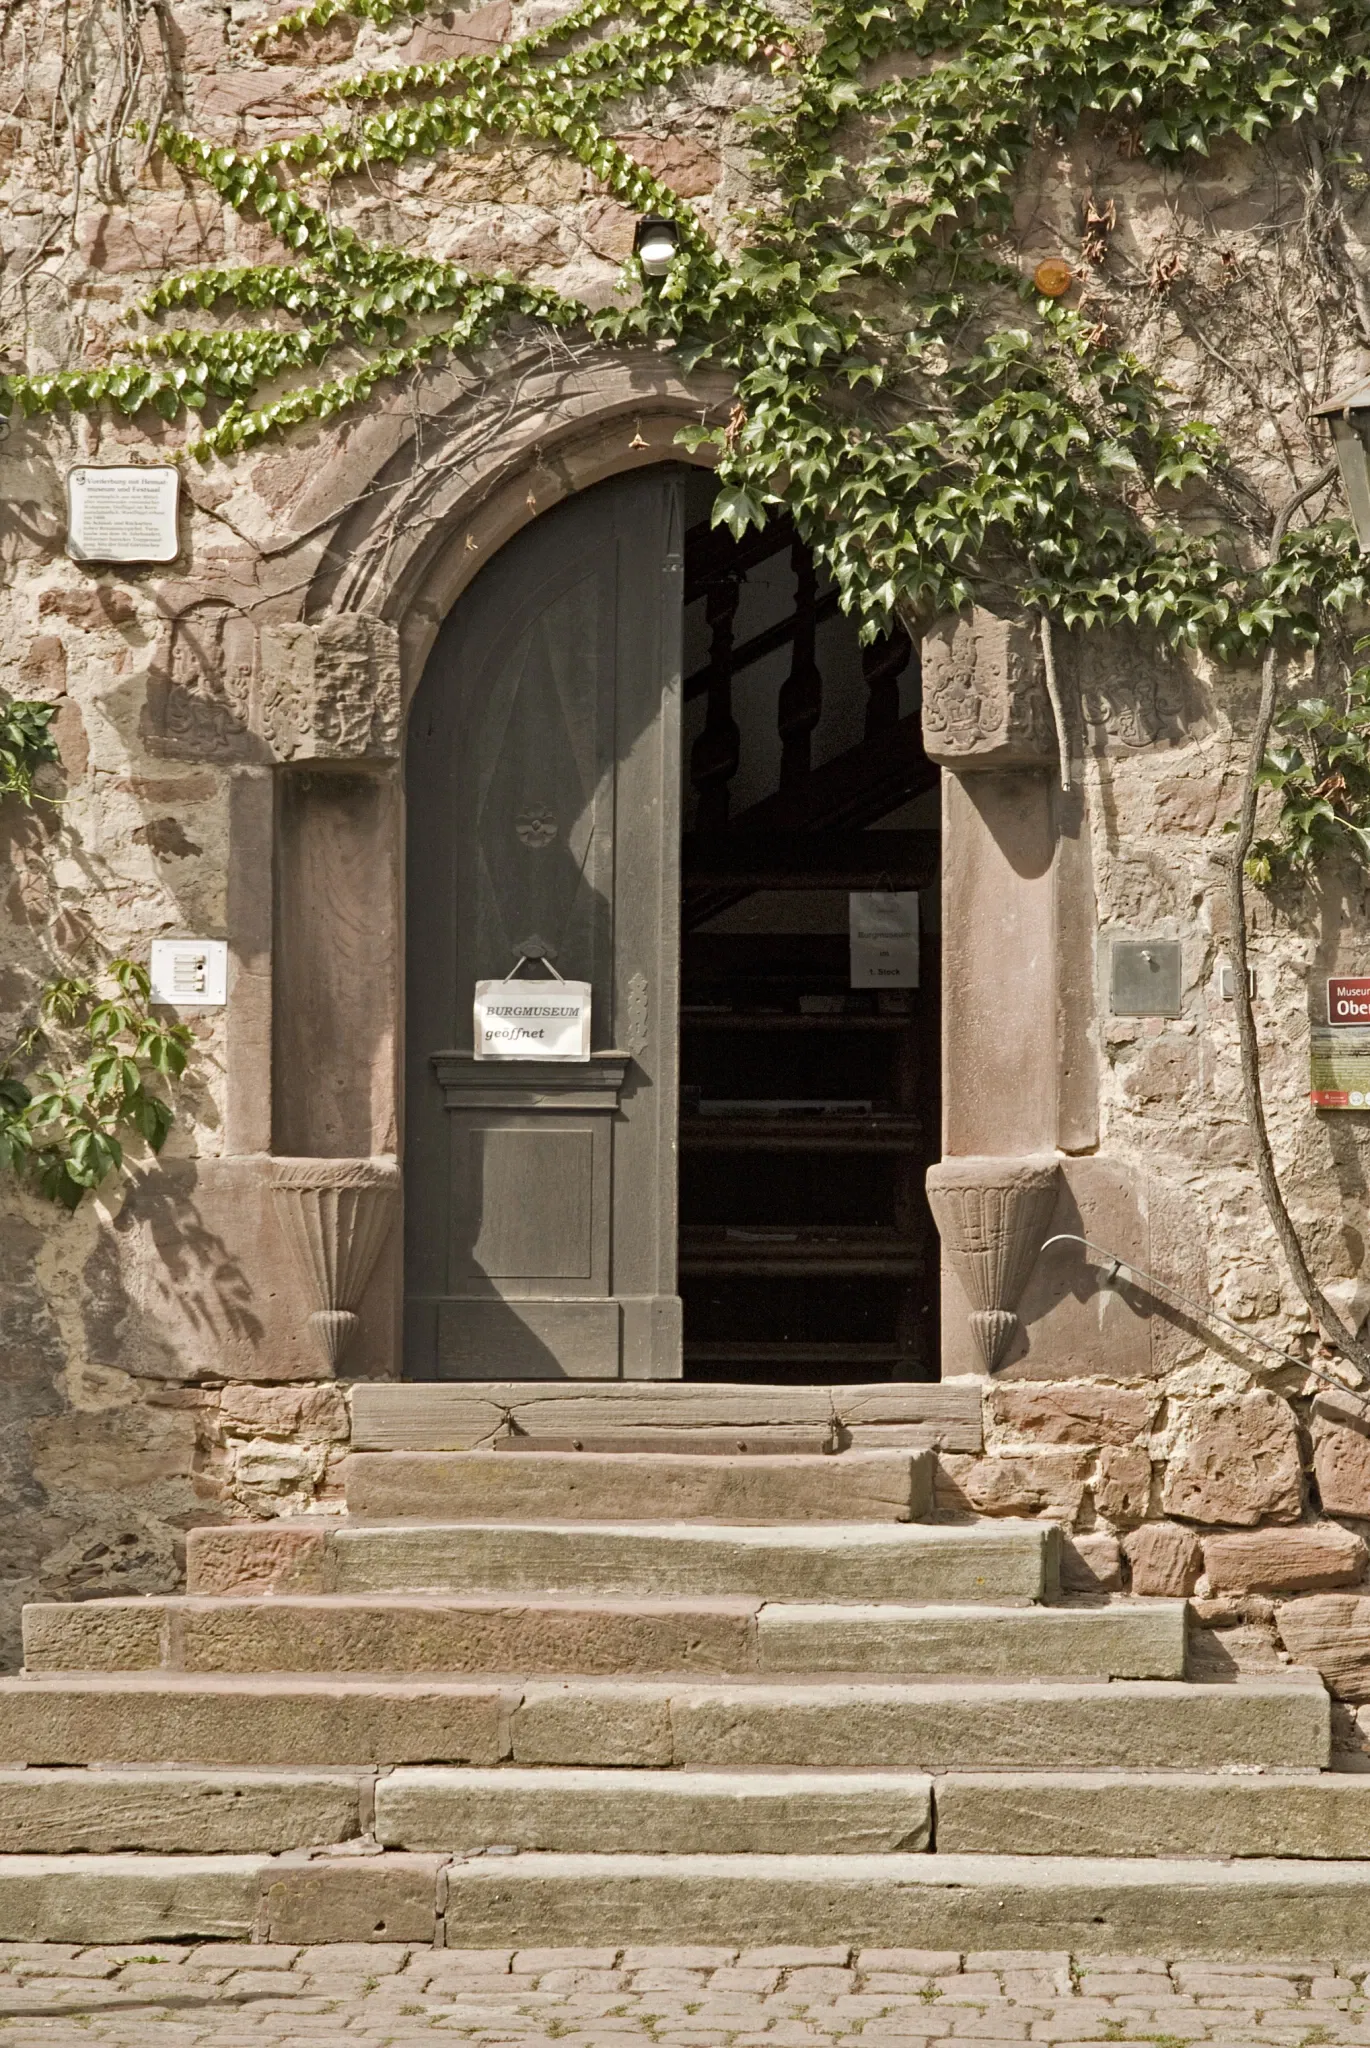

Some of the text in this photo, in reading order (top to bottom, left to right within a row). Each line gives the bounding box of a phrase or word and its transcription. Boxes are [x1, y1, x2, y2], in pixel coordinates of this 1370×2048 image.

[878, 967, 900, 976] Stock
[486, 1006, 580, 1017] BURGMUSEUM
[485, 1027, 545, 1041] geöffnet
